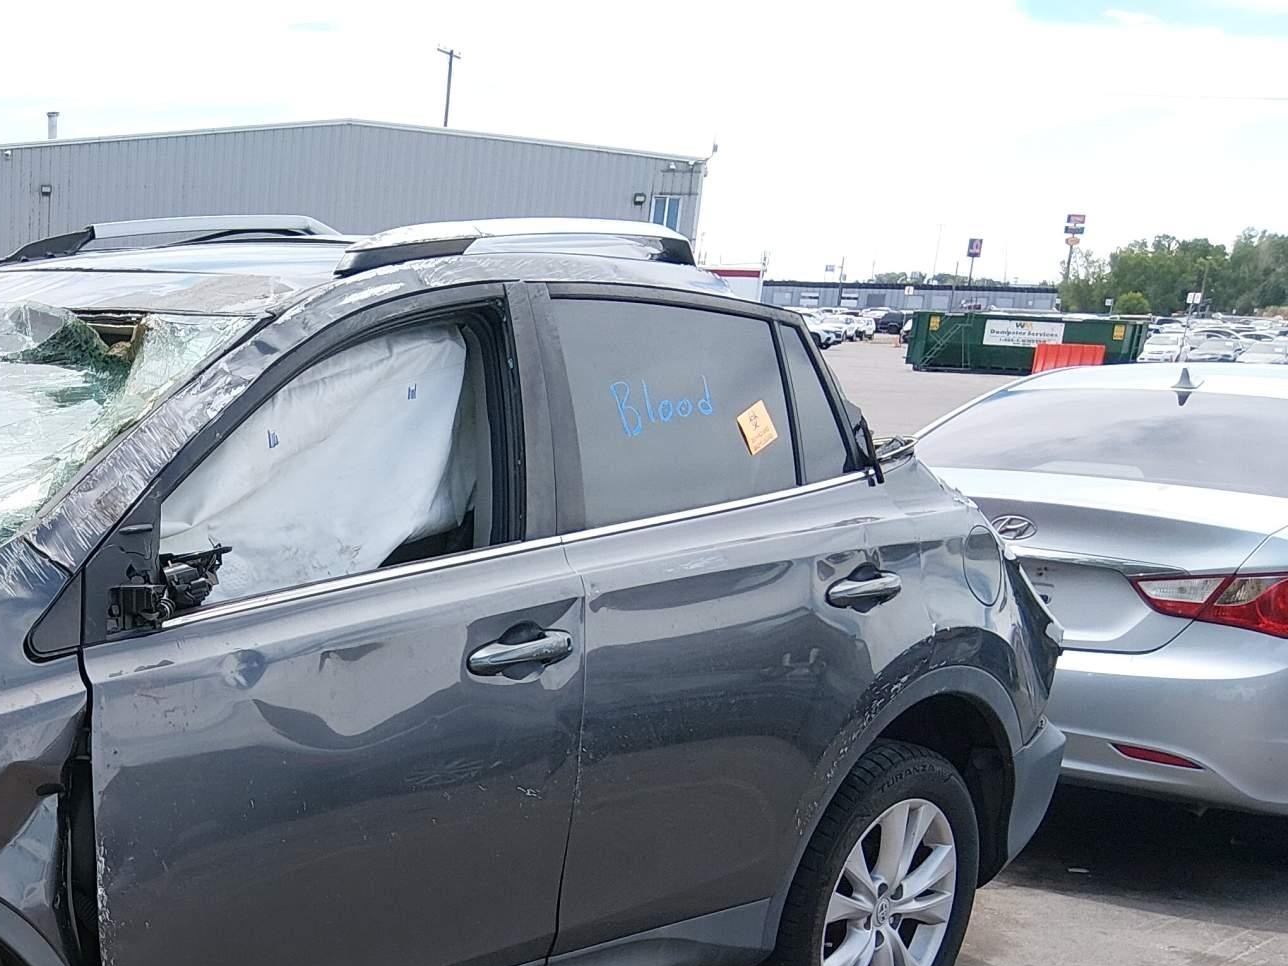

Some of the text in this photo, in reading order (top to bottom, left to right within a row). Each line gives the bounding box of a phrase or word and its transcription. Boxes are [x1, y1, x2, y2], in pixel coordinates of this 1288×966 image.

[990, 329, 1026, 337] Dumpster
[609, 375, 713, 437] Blood
[878, 764, 935, 793] TURANZA
